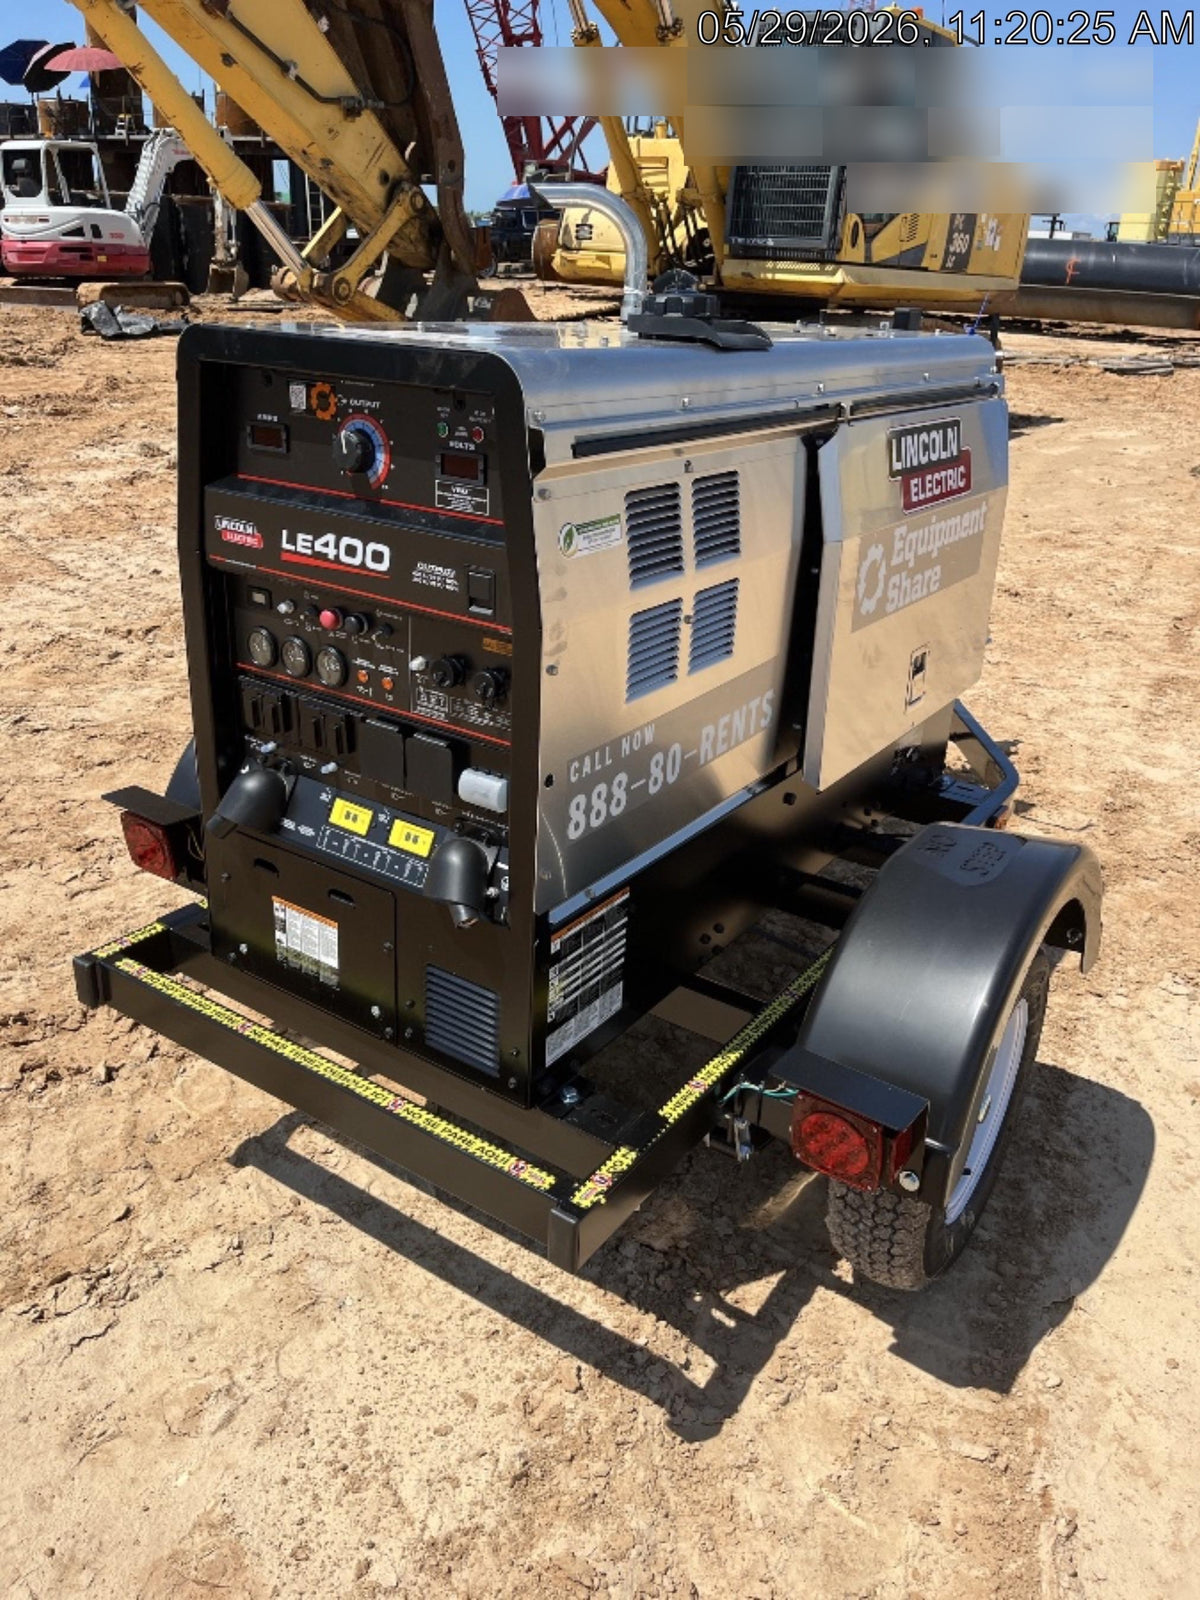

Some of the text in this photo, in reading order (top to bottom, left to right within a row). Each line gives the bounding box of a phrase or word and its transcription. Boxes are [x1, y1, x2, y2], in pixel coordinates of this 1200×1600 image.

[349, 398, 381, 409] OUTPUT
[448, 440, 476, 451] VOLTS
[890, 426, 960, 471] LINCOLN
[909, 465, 967, 502] ELECTRIC
[281, 529, 391, 572] LE400
[890, 501, 988, 568] Equipment
[885, 564, 942, 614] Share
[566, 688, 776, 840] 888-80-RENTS
[569, 723, 656, 784] CALL NOW
[401, 1106, 511, 1166] NO SE PARE AQUI
